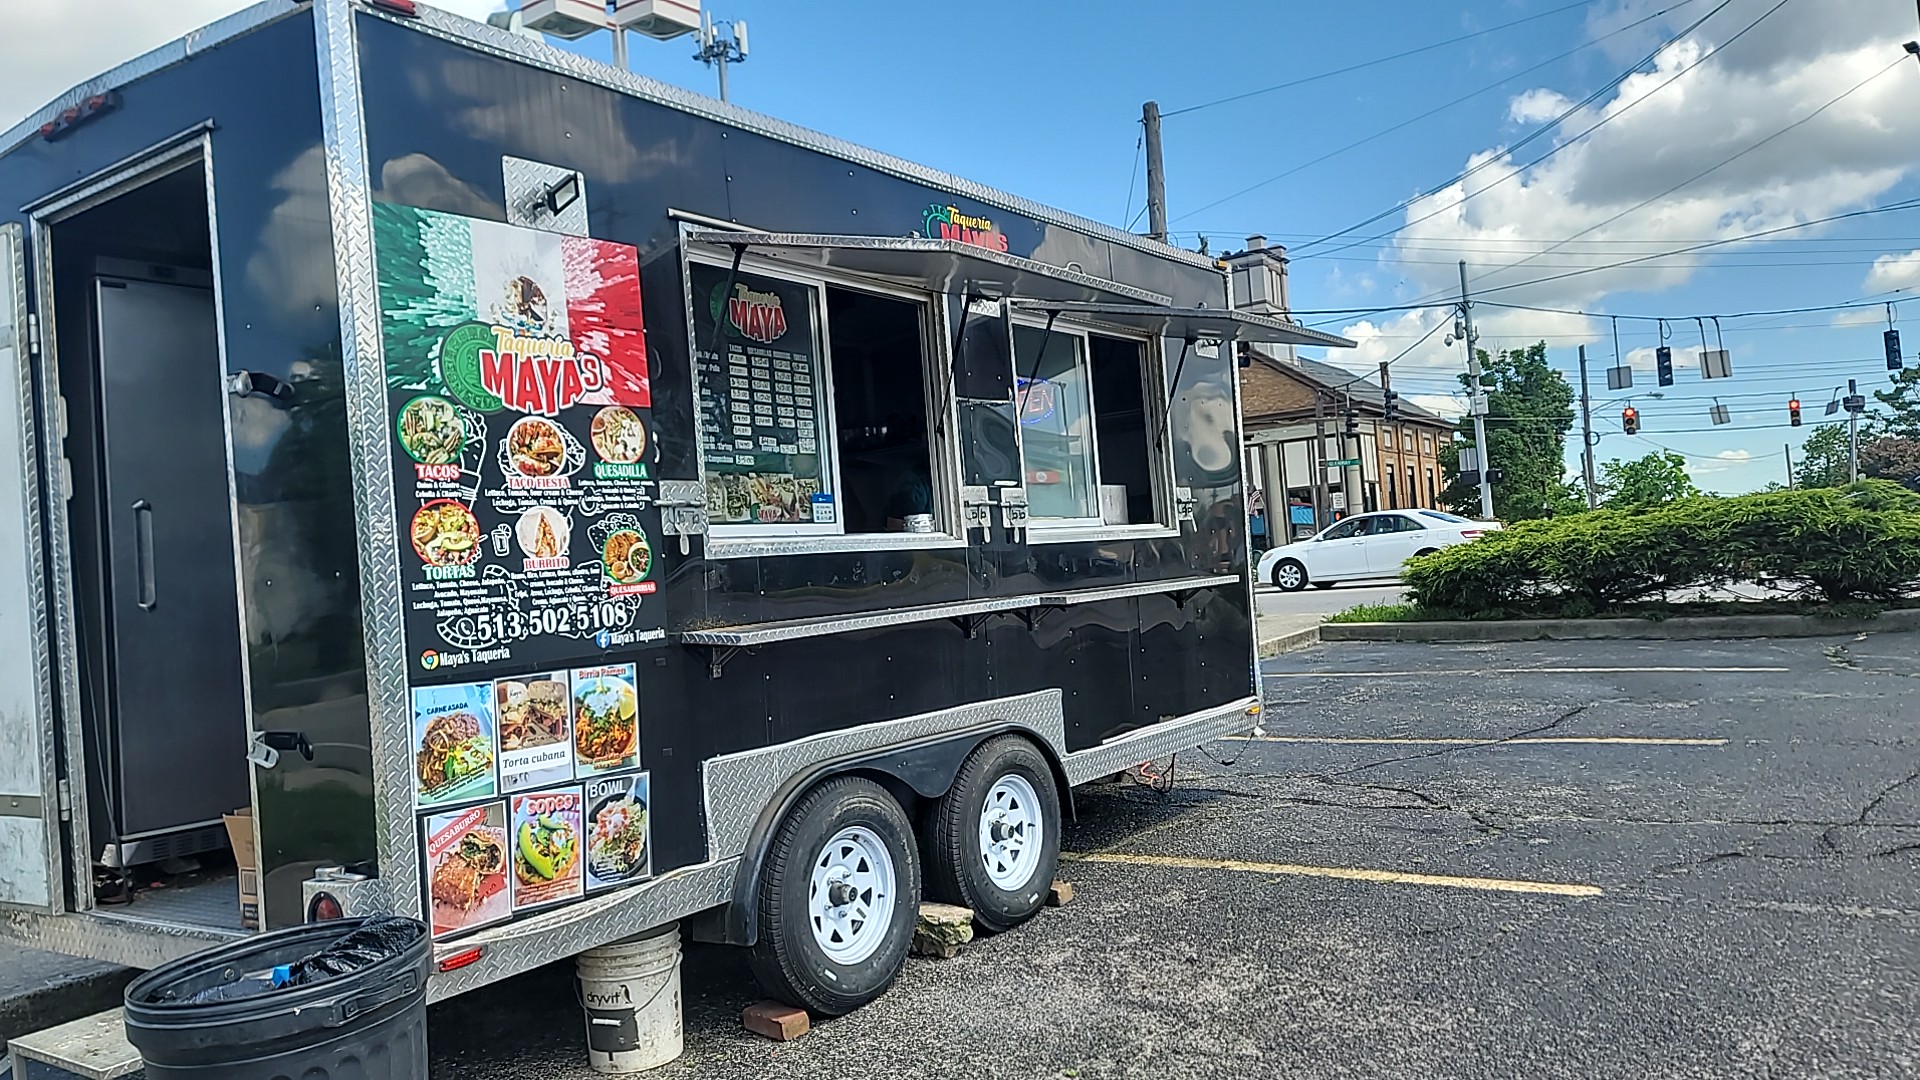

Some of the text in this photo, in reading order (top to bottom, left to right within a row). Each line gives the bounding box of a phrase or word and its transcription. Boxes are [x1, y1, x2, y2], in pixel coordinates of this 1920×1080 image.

[730, 298, 786, 343] MAYA
[416, 465, 459, 478] TACOS
[595, 464, 648, 479] QUESADILLA
[509, 478, 569, 488] TACO FIESTA
[525, 558, 569, 569] BURRITO
[424, 565, 476, 580] TORTAS
[477, 602, 627, 641] 513 502 5108
[611, 627, 665, 646] Maya's Taqueria
[440, 646, 510, 668] Maya's Taqueria
[579, 668, 626, 679] Birria Ramen
[426, 702, 468, 715] CARNE ASADA
[503, 757, 529, 769] Torta
[531, 751, 565, 763] cubana
[590, 780, 627, 798] BOWL
[526, 795, 573, 818] sopes
[429, 809, 481, 853] QUESABURRO
[587, 991, 620, 1007] dryvit
